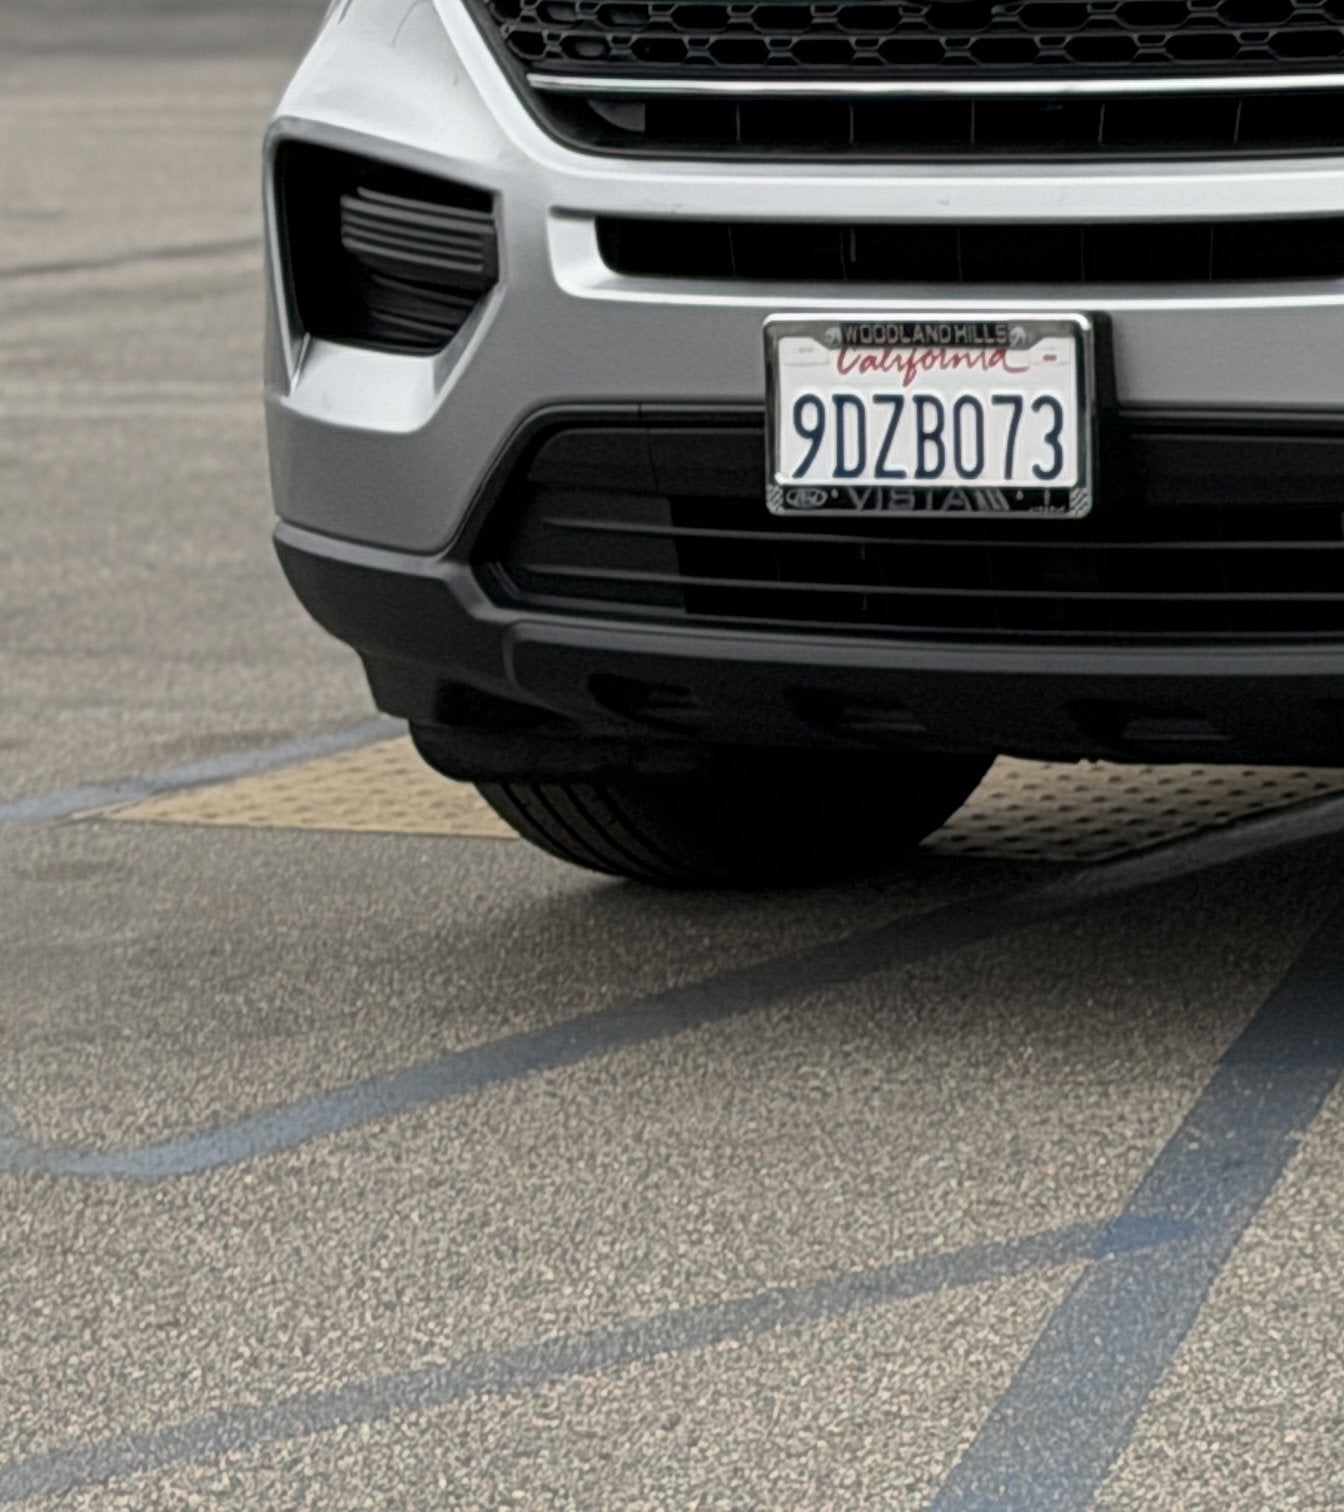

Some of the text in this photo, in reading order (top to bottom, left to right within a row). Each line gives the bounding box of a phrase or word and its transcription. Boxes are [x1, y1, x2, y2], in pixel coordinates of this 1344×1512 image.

[843, 322, 1008, 345] WOODLAND HILLS
[837, 345, 1030, 387] California
[792, 392, 1064, 480] 9DZB073
